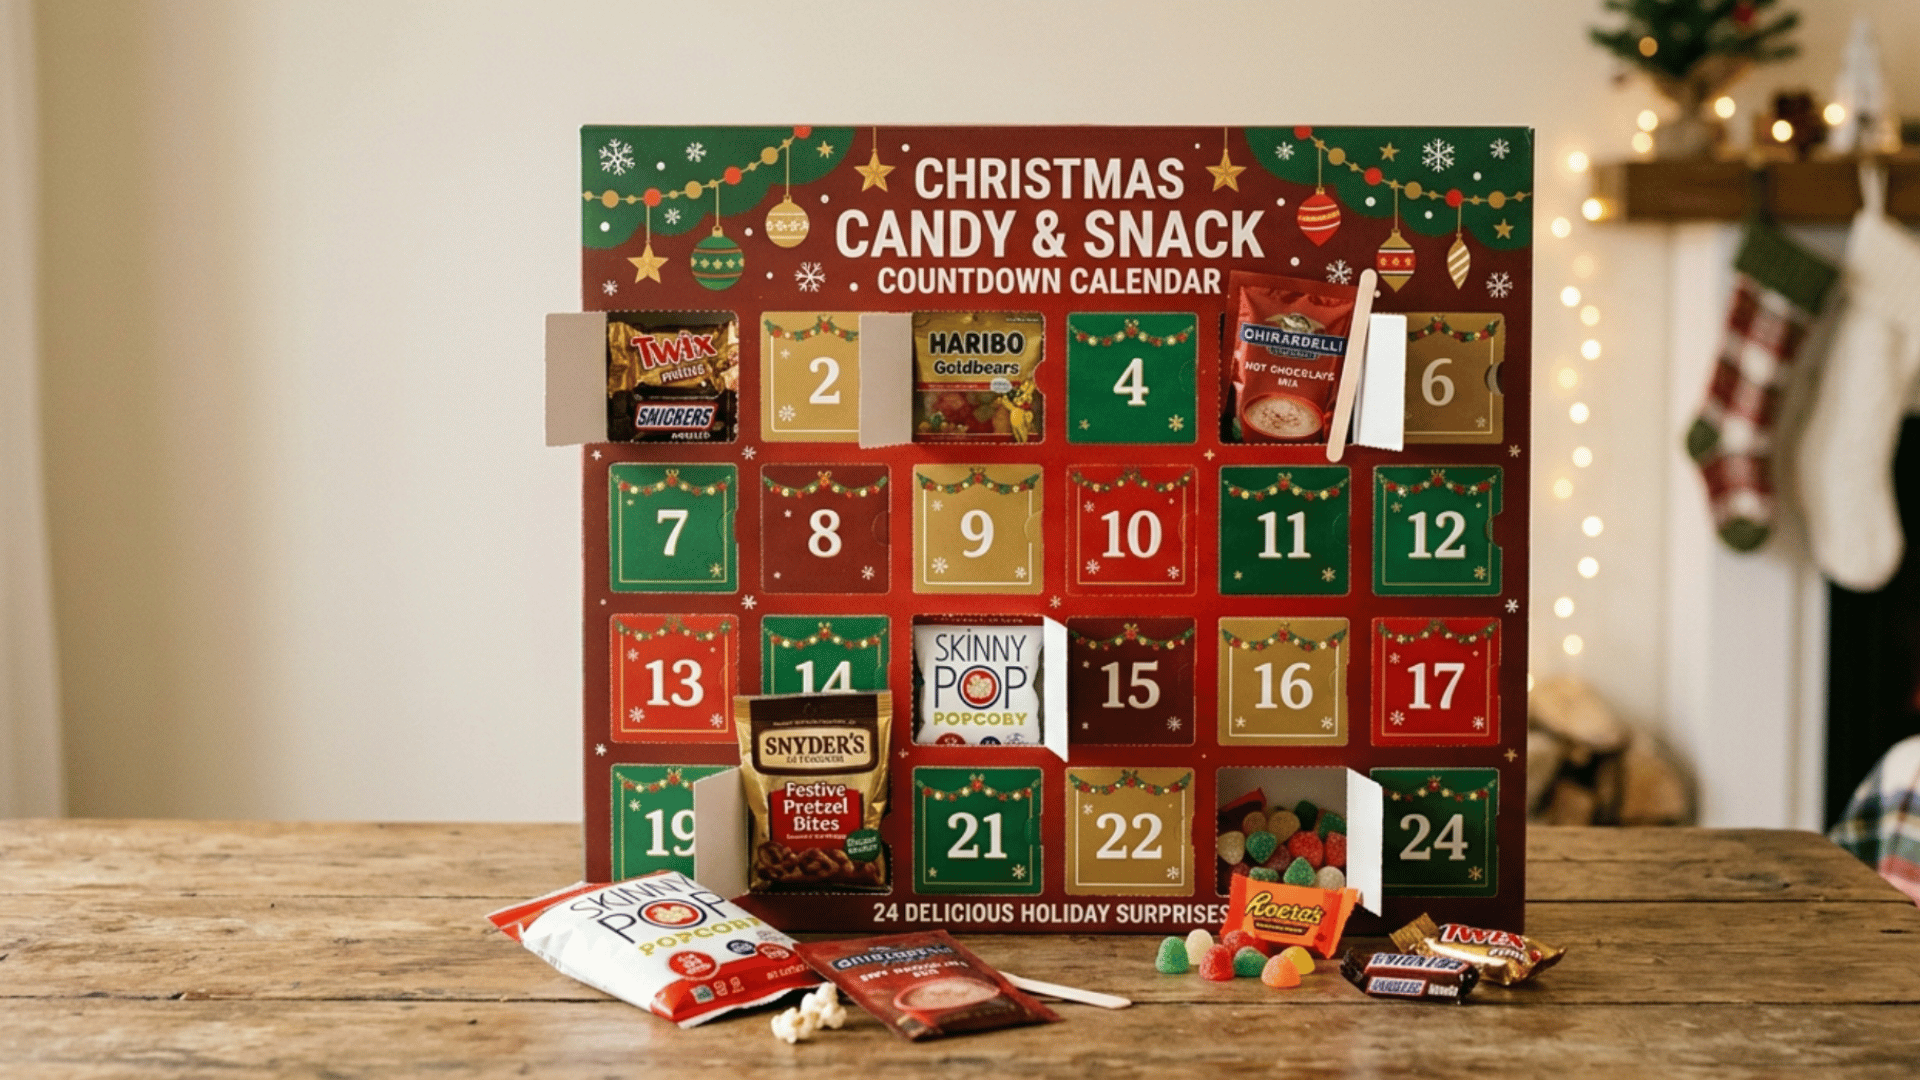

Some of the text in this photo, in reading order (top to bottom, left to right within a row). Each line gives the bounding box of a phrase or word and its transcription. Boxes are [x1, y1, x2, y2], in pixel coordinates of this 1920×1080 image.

[914, 157, 1186, 200] CHRISTMAS
[835, 209, 1266, 259] CANDY & SNACK
[877, 267, 1221, 295] COUNTDOWN CALENDAR
[929, 331, 1025, 355] HARIBO
[809, 356, 841, 405] 2
[933, 360, 1020, 375] Goldbears
[1113, 357, 1150, 407] 4
[1421, 357, 1456, 407] 6
[656, 508, 689, 557] 7
[807, 508, 843, 558] 8
[959, 508, 995, 558] 9
[1100, 510, 1163, 559] 10
[1256, 510, 1312, 559] 11
[1407, 510, 1468, 559] 12
[645, 659, 705, 707] 13
[795, 660, 858, 693] 14
[934, 664, 1028, 711] POP
[1100, 660, 1162, 709] 15
[1253, 661, 1314, 710] 16
[1406, 661, 1466, 710] 17
[933, 711, 1028, 726] POPCOBY
[765, 732, 866, 756] SNYDER'S
[783, 796, 849, 815] Pretzel
[785, 781, 846, 798] Festive
[645, 808, 695, 857] 19
[793, 815, 840, 832] Bites
[947, 811, 1008, 859] 21
[1095, 812, 1164, 861] 22
[1399, 813, 1469, 861] 24
[569, 874, 698, 920] SKINNY
[597, 890, 727, 945] POP
[873, 902, 1230, 924] 24 DELICIOUS HOLIDAY SURPRISES
